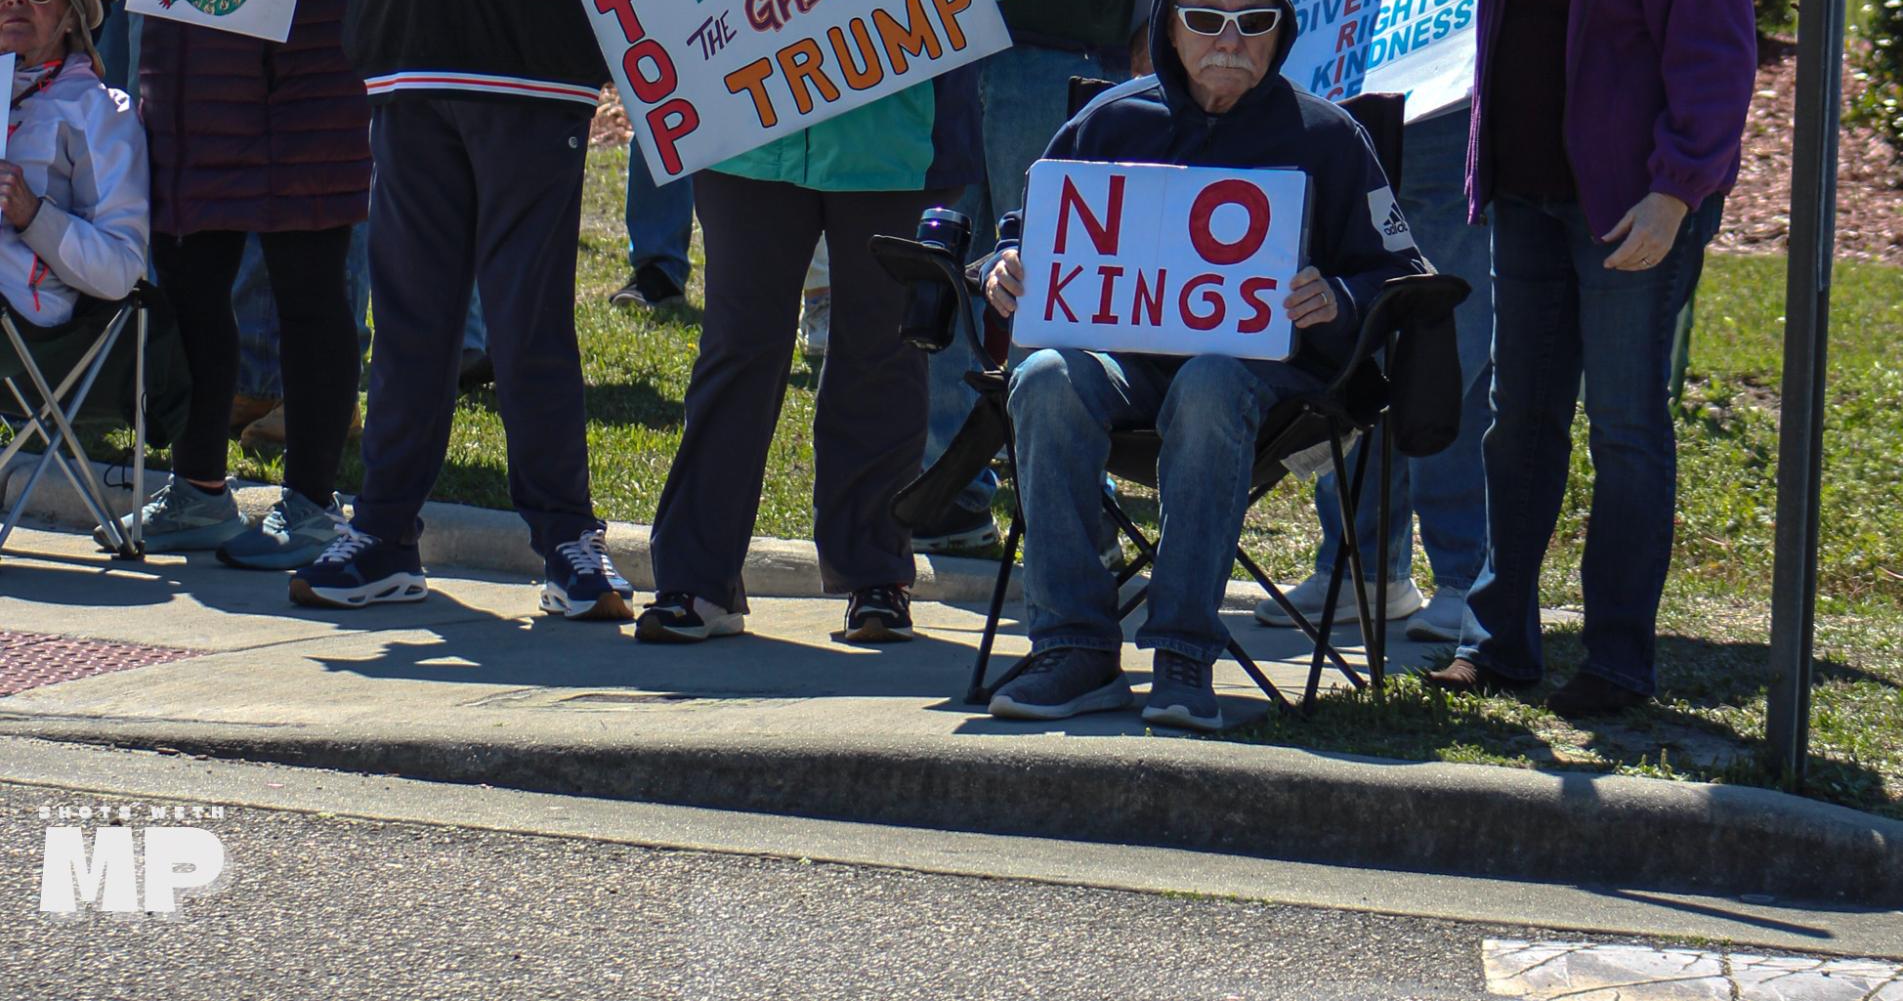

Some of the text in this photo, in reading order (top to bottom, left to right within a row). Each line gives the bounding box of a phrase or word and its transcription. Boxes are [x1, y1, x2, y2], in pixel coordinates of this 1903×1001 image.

[686, 9, 738, 61] THE
[1053, 173, 1272, 266] NO
[1043, 262, 1278, 334] KINGS
